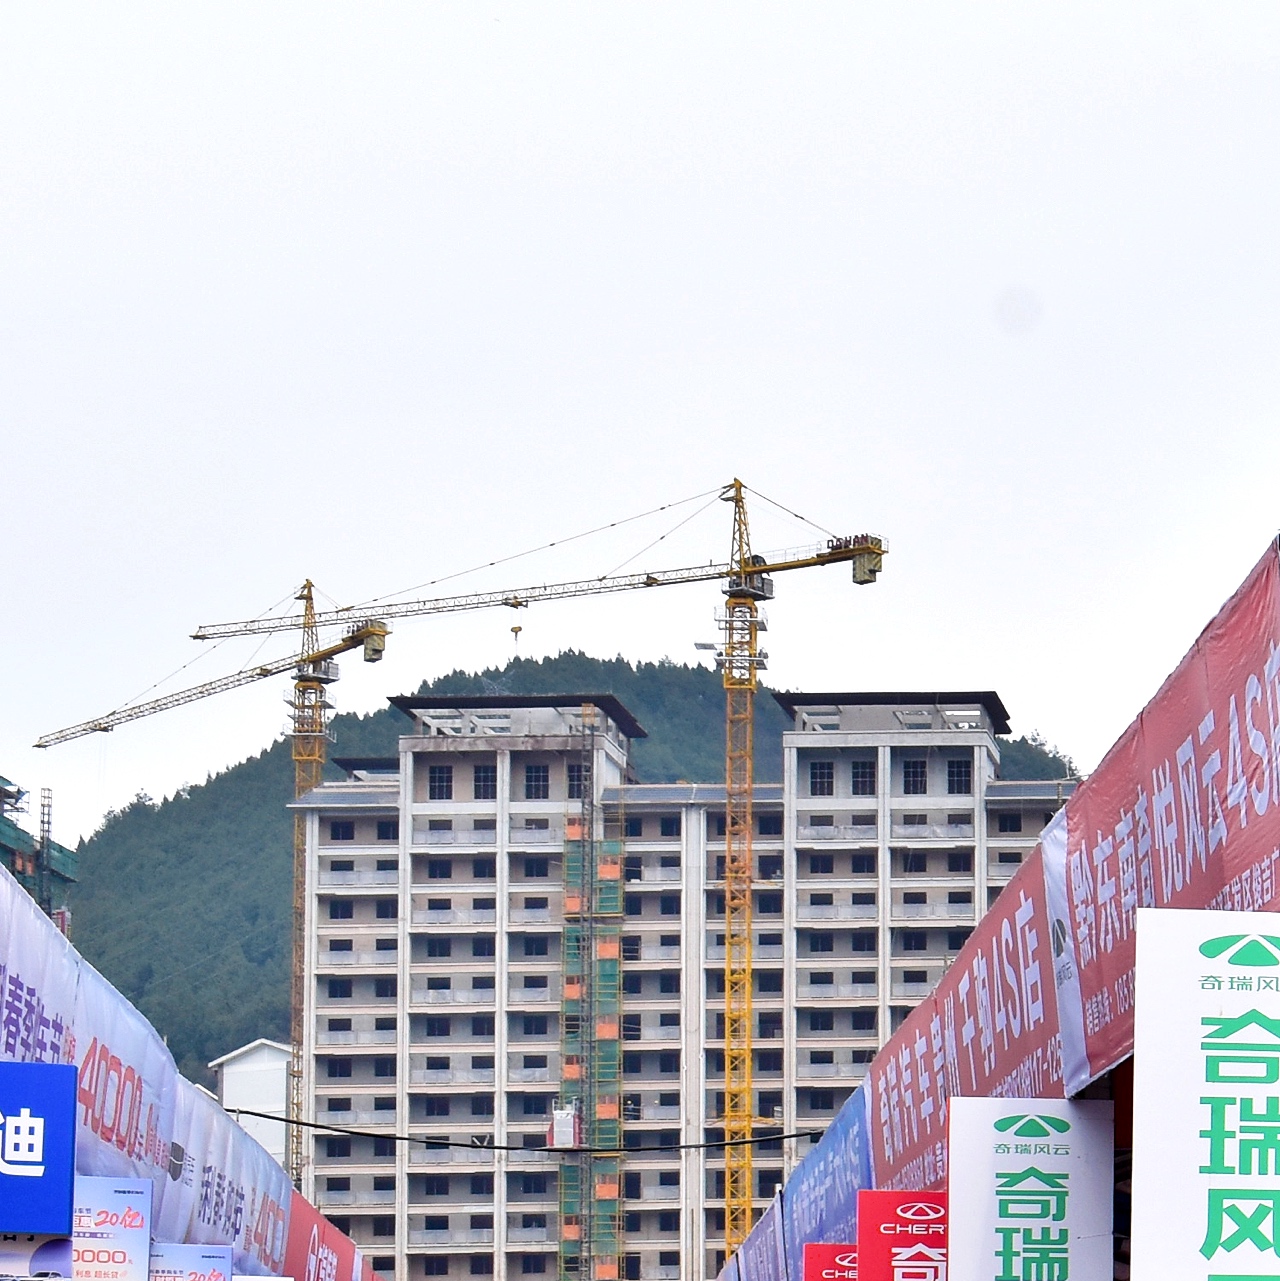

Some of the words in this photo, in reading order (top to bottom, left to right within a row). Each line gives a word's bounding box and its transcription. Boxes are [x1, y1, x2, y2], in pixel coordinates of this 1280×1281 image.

[993, 1144, 1070, 1155] 奇瑞风云
[880, 1223, 947, 1235] CHER
